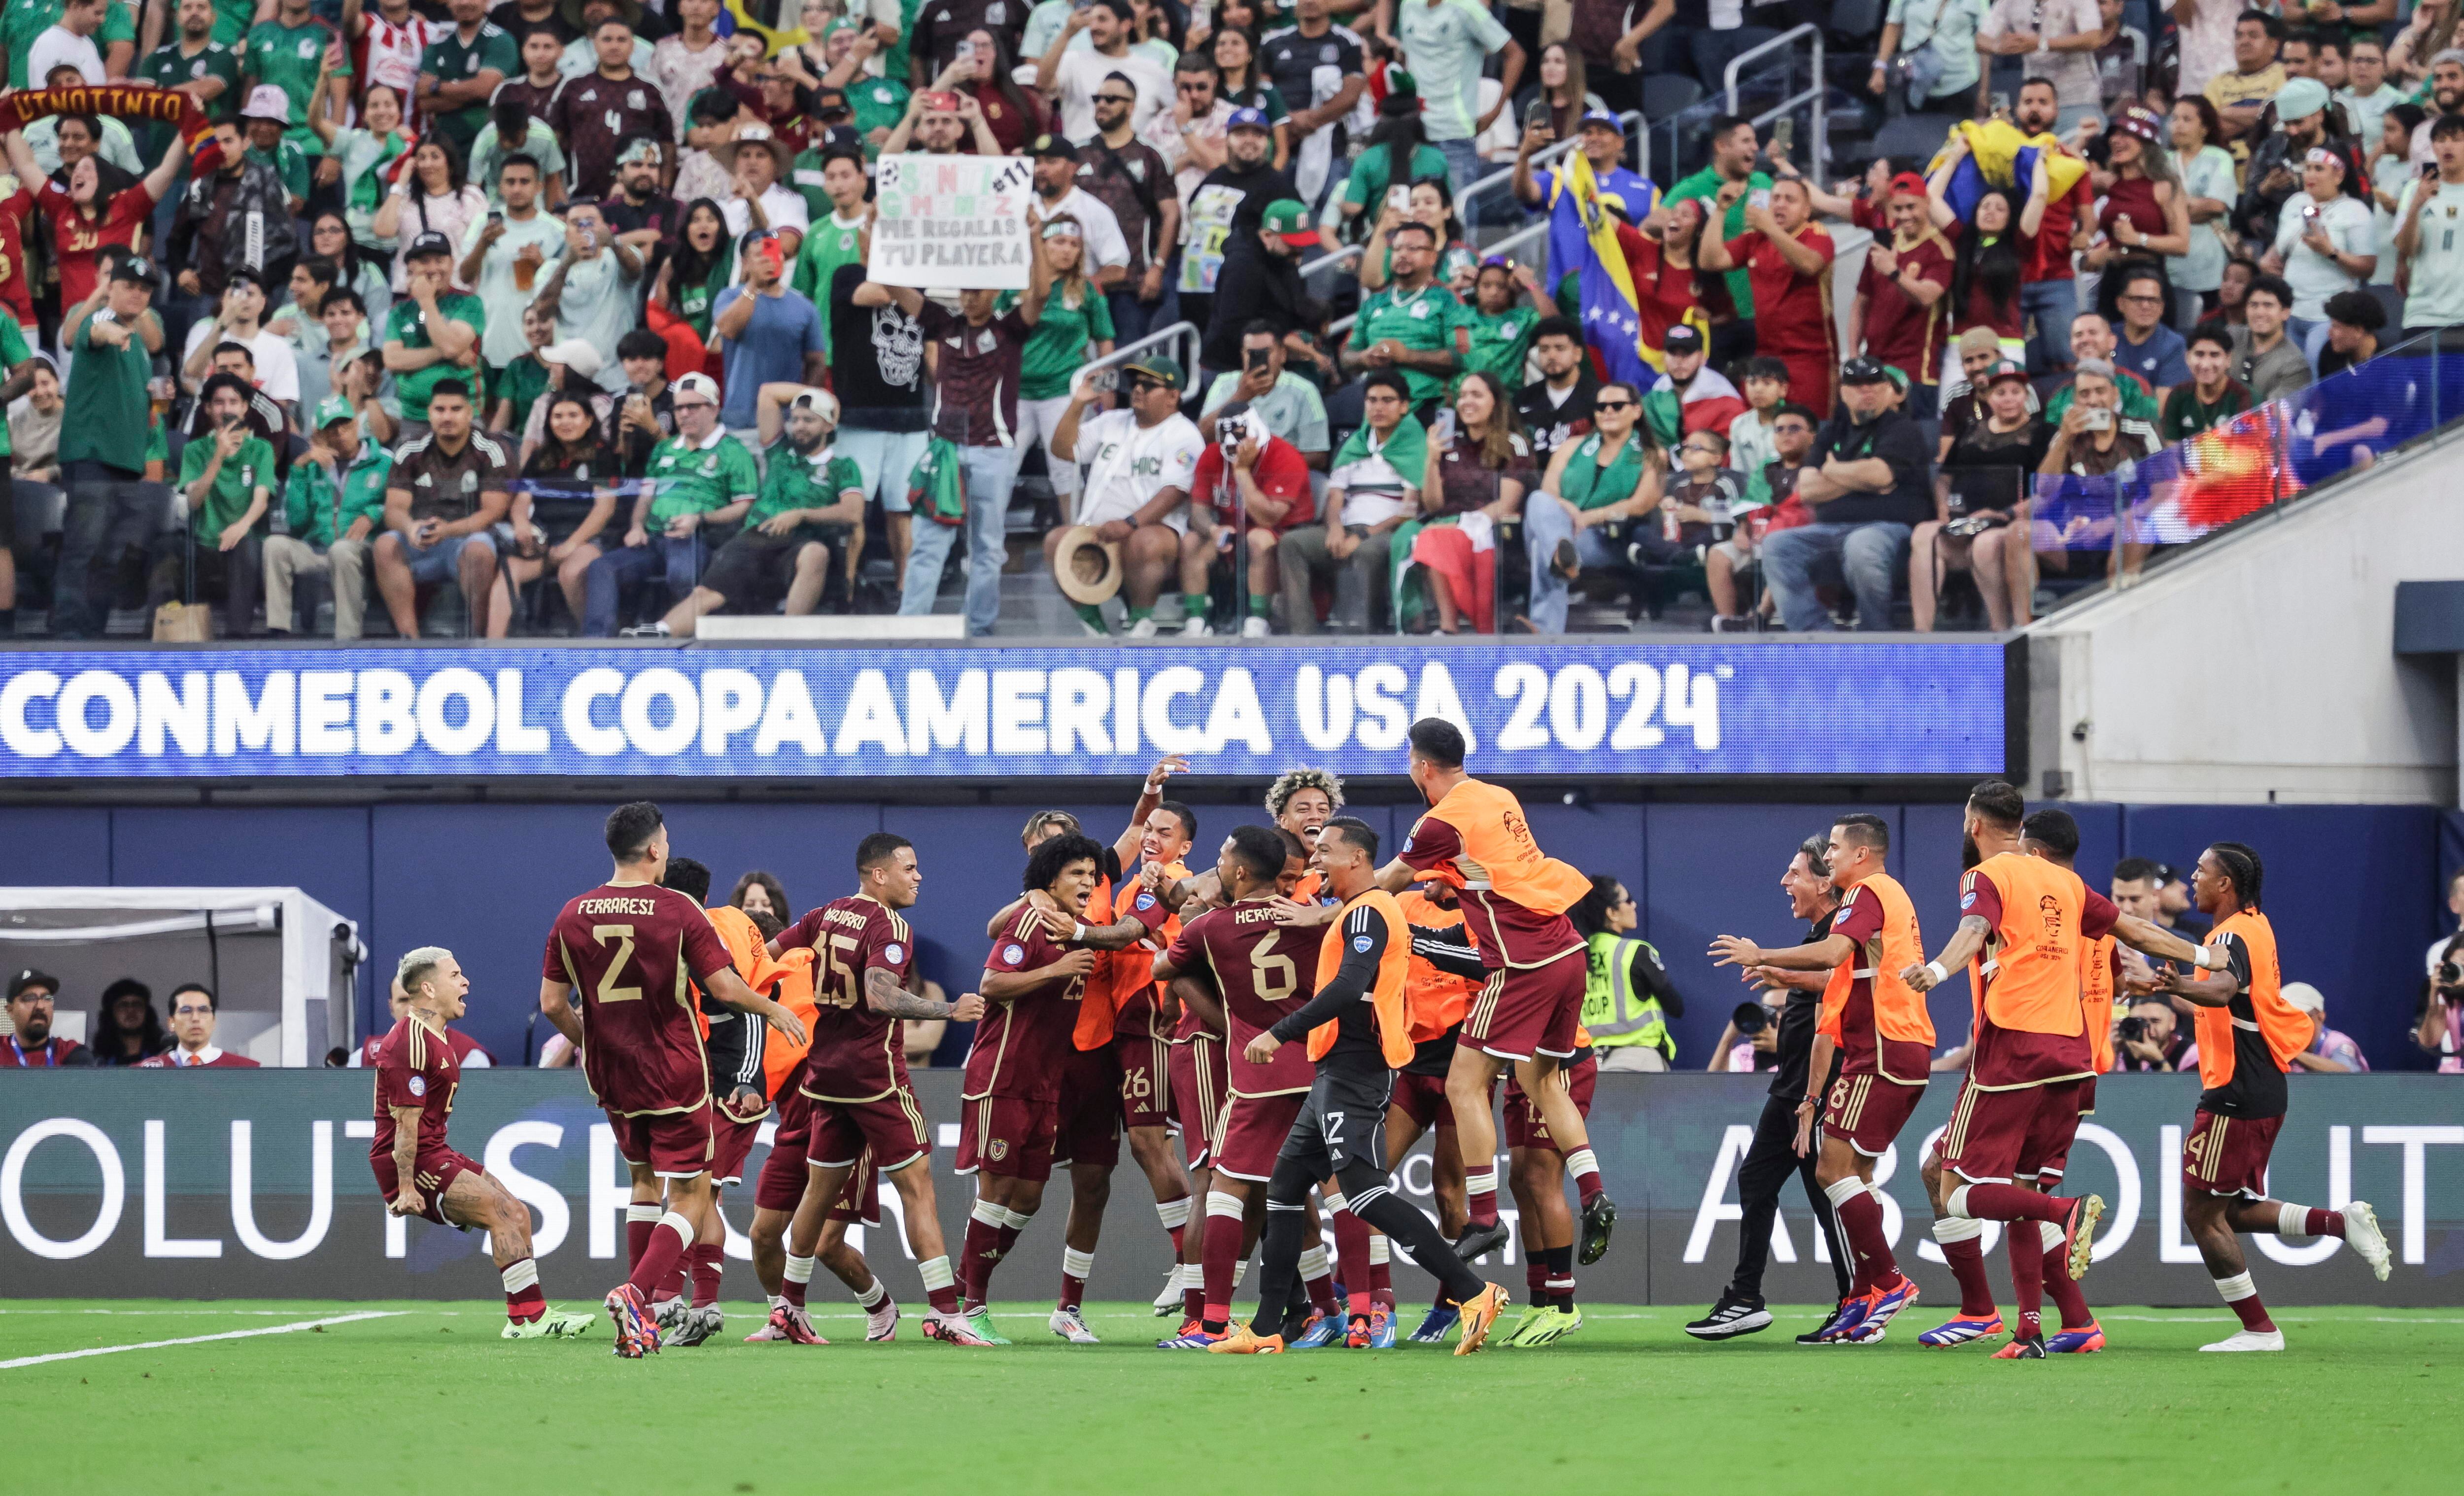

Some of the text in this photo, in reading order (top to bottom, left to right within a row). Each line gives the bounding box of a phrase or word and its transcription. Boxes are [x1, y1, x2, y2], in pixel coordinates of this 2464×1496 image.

[605, 109, 621, 136] 4
[992, 160, 1029, 192] #11
[880, 218, 1017, 239] ME REGALAS
[881, 242, 1025, 267] TU PLAYERA
[0, 661, 1721, 758] CONMEBOL COPA AMERICA USA 2024
[578, 897, 655, 915] FERRARESI
[1235, 907, 1292, 924] HERR
[593, 924, 642, 1004] 2
[812, 930, 858, 1009] 15
[1250, 928, 1297, 1001] 6
[1830, 1078, 1850, 1109] 8
